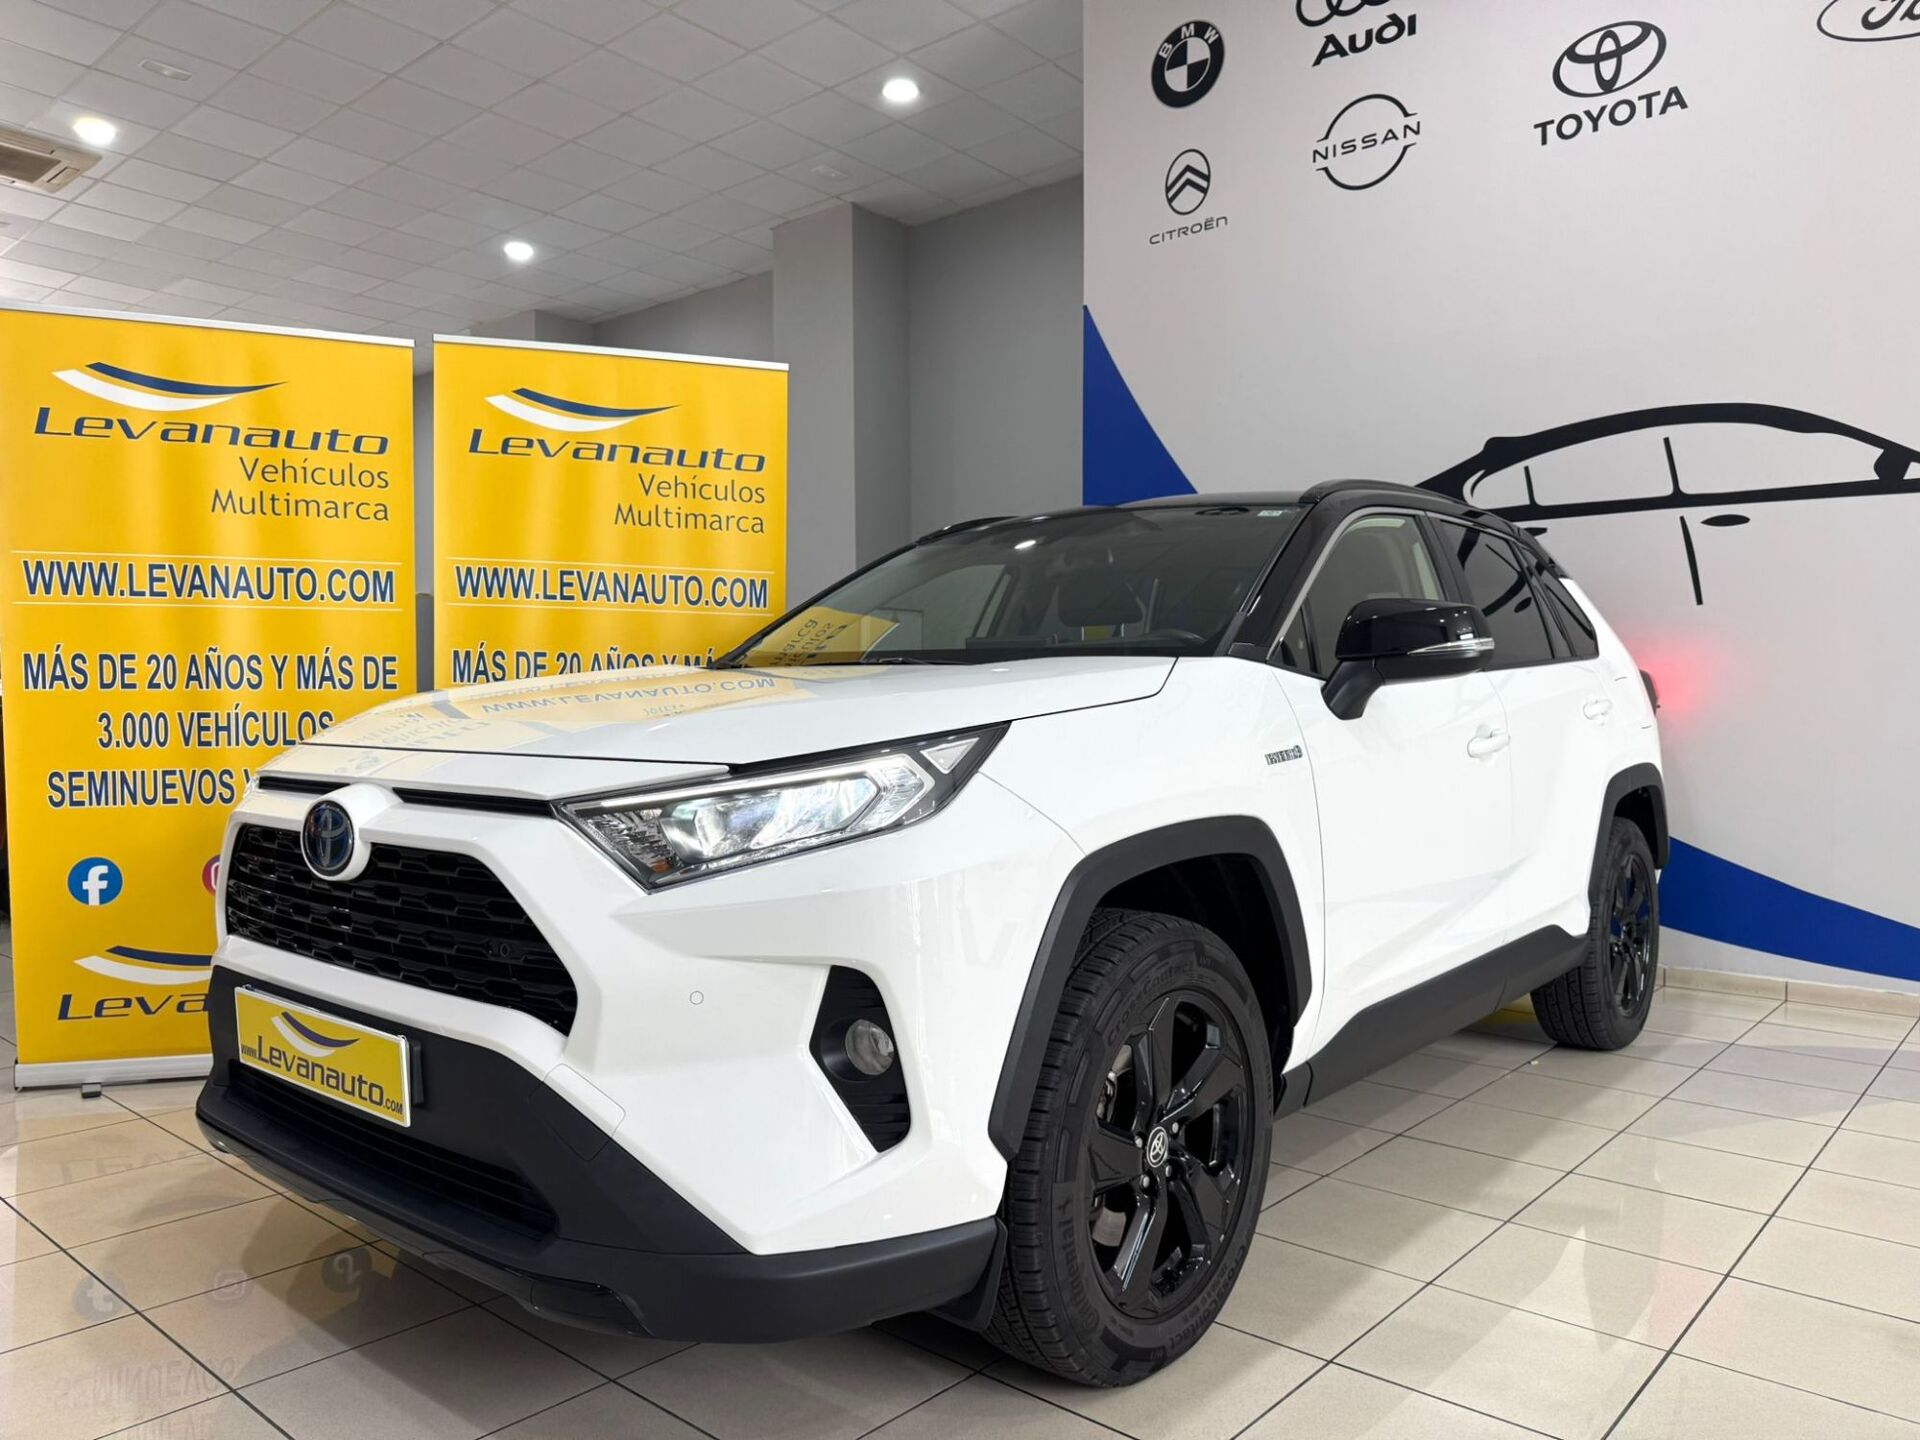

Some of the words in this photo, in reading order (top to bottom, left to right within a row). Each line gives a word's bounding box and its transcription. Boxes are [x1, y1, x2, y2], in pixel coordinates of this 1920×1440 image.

[1158, 22, 1219, 59] BMW
[1311, 13, 1417, 67] Audi
[1533, 86, 1688, 148] TOYOTA
[1311, 121, 1421, 164] NISSAN
[33, 406, 390, 456] Levanauto
[468, 428, 767, 473] Levanauto
[238, 455, 390, 490] Vehículos
[638, 472, 766, 505] Vehículos
[210, 488, 390, 522] Multimarca
[613, 503, 765, 535] Multimarca
[22, 559, 395, 604] WWW.LEVANAUTO.COM
[454, 565, 769, 610] WWW.LEVANAUTO.COM
[23, 644, 89, 690] MÁS
[98, 653, 138, 690] DE
[146, 655, 178, 691] 20
[184, 645, 264, 691] AÑOS
[270, 654, 290, 691] Y
[295, 646, 353, 691] MÁS
[362, 655, 398, 691] DE
[451, 641, 508, 684] MÁS
[515, 649, 547, 680] DE
[556, 651, 583, 676] 20
[96, 711, 170, 748] 3.000
[47, 769, 236, 808] SEMINUEVOS
